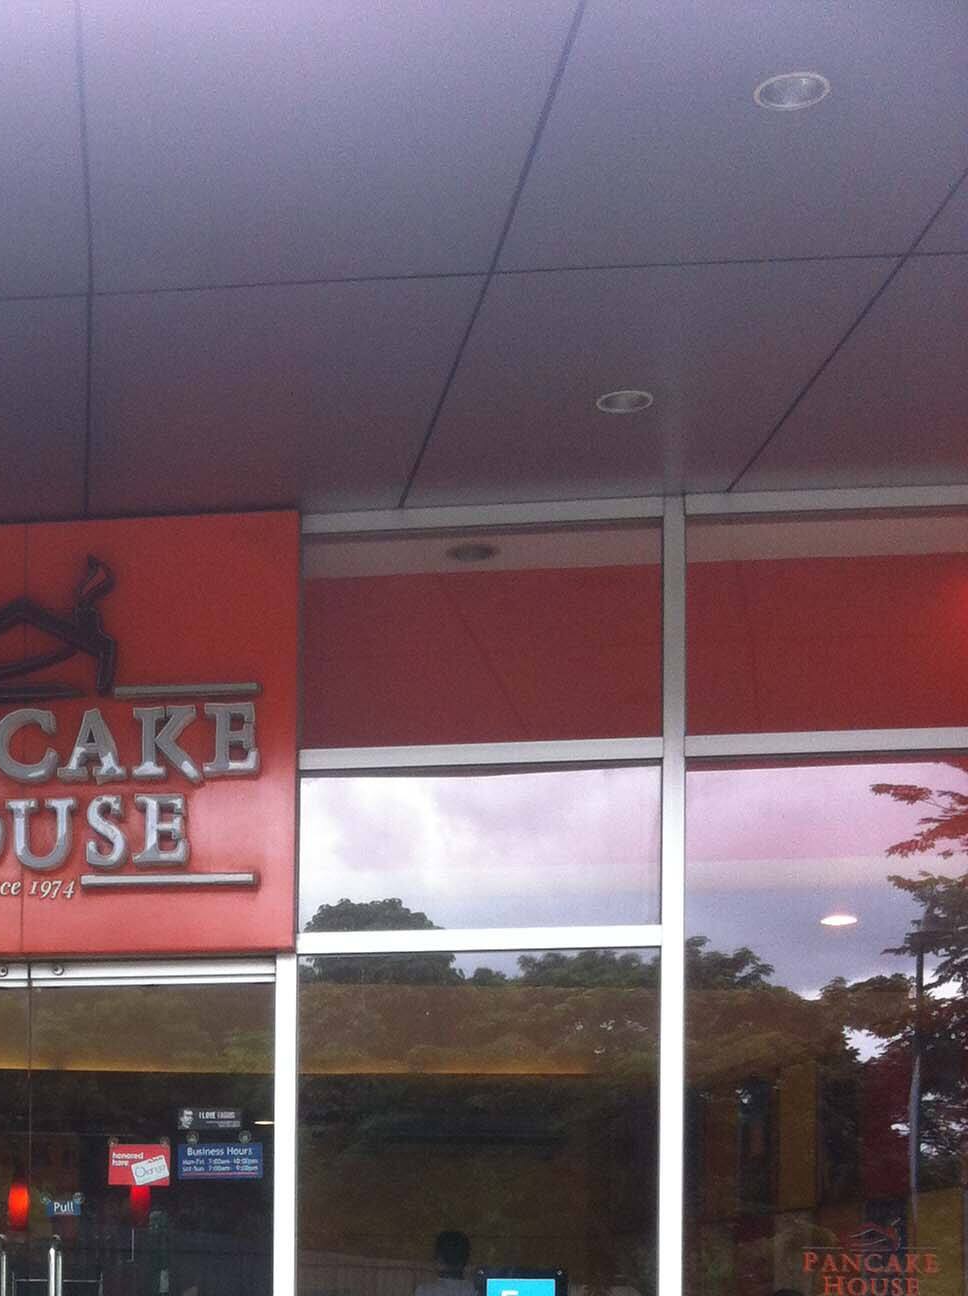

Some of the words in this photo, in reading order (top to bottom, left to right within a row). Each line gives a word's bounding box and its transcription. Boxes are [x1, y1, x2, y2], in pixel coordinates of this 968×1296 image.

[29, 880, 75, 899] 1974
[187, 1147, 224, 1156] Business
[227, 1147, 253, 1155] Hours
[53, 1201, 74, 1212] Pull
[802, 1252, 940, 1273] PANCAKE
[823, 1275, 919, 1296] HOUSE
